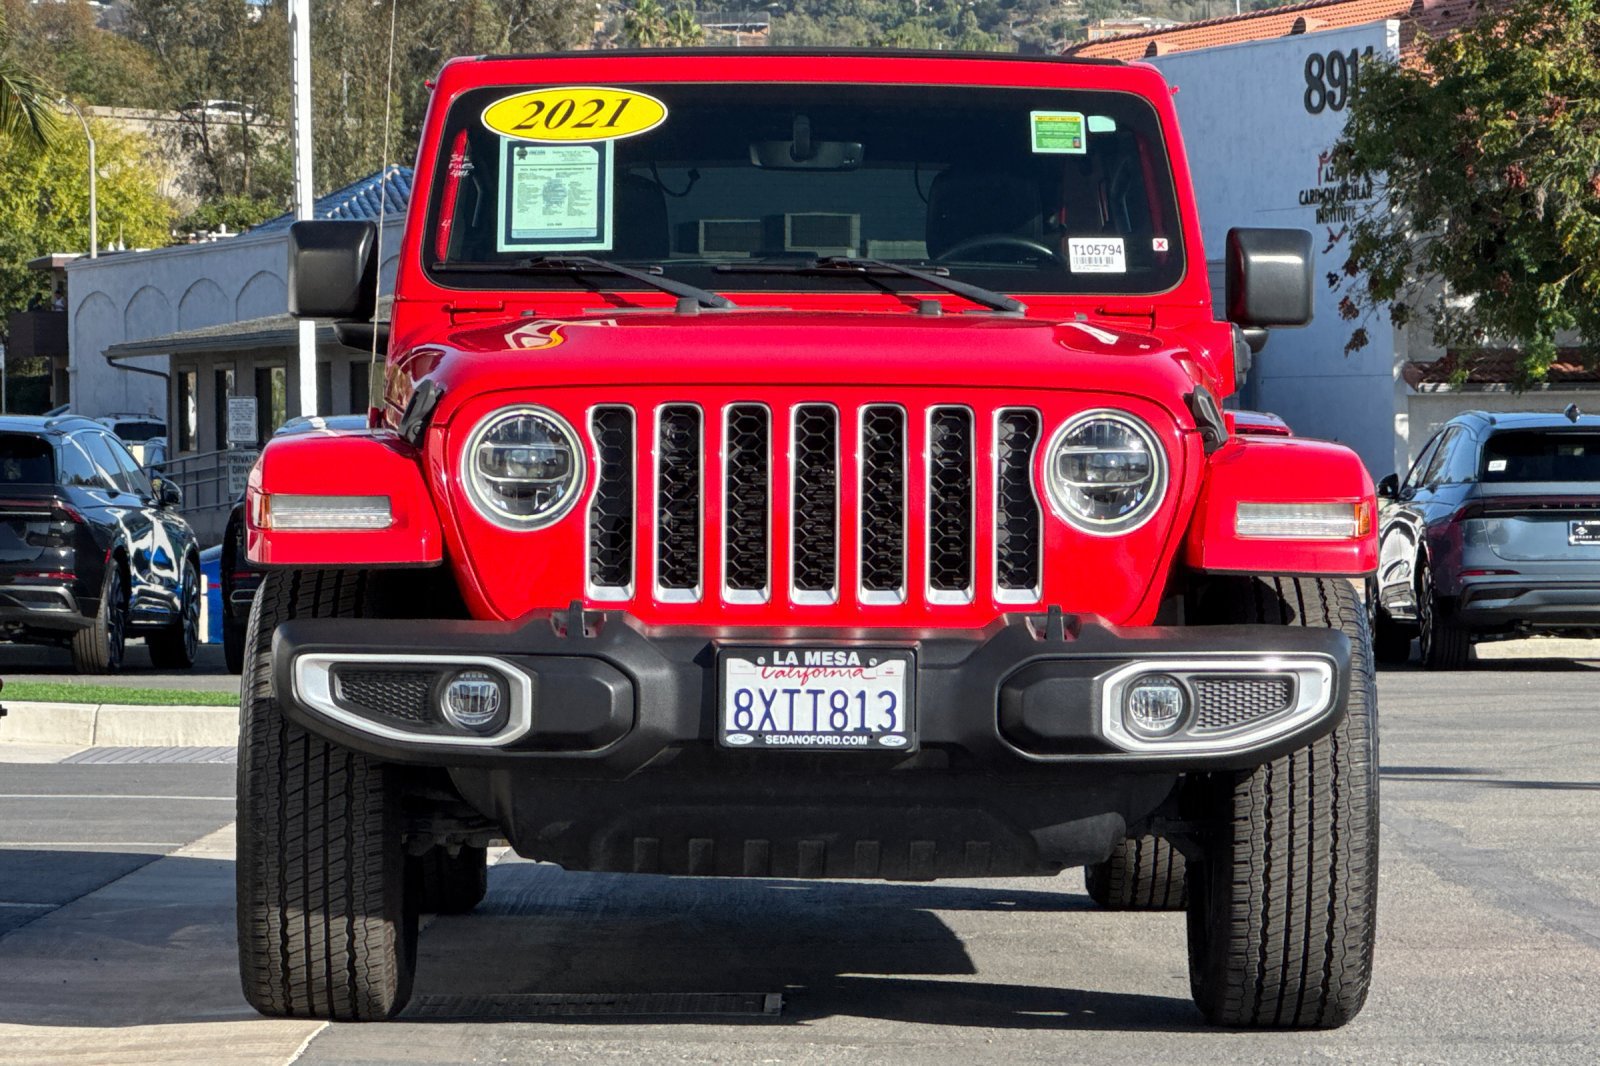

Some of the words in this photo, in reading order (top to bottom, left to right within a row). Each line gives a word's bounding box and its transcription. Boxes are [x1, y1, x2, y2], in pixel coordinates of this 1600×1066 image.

[1304, 46, 1374, 114] 891
[511, 97, 632, 131] 2021
[1072, 244, 1123, 256] T105794
[232, 465, 252, 474] DRIV
[773, 651, 799, 665] LA
[804, 651, 860, 666] MESA
[761, 666, 877, 686] California
[733, 688, 897, 733] 8XTT813
[765, 734, 868, 745] SEDANOFORD.COM
